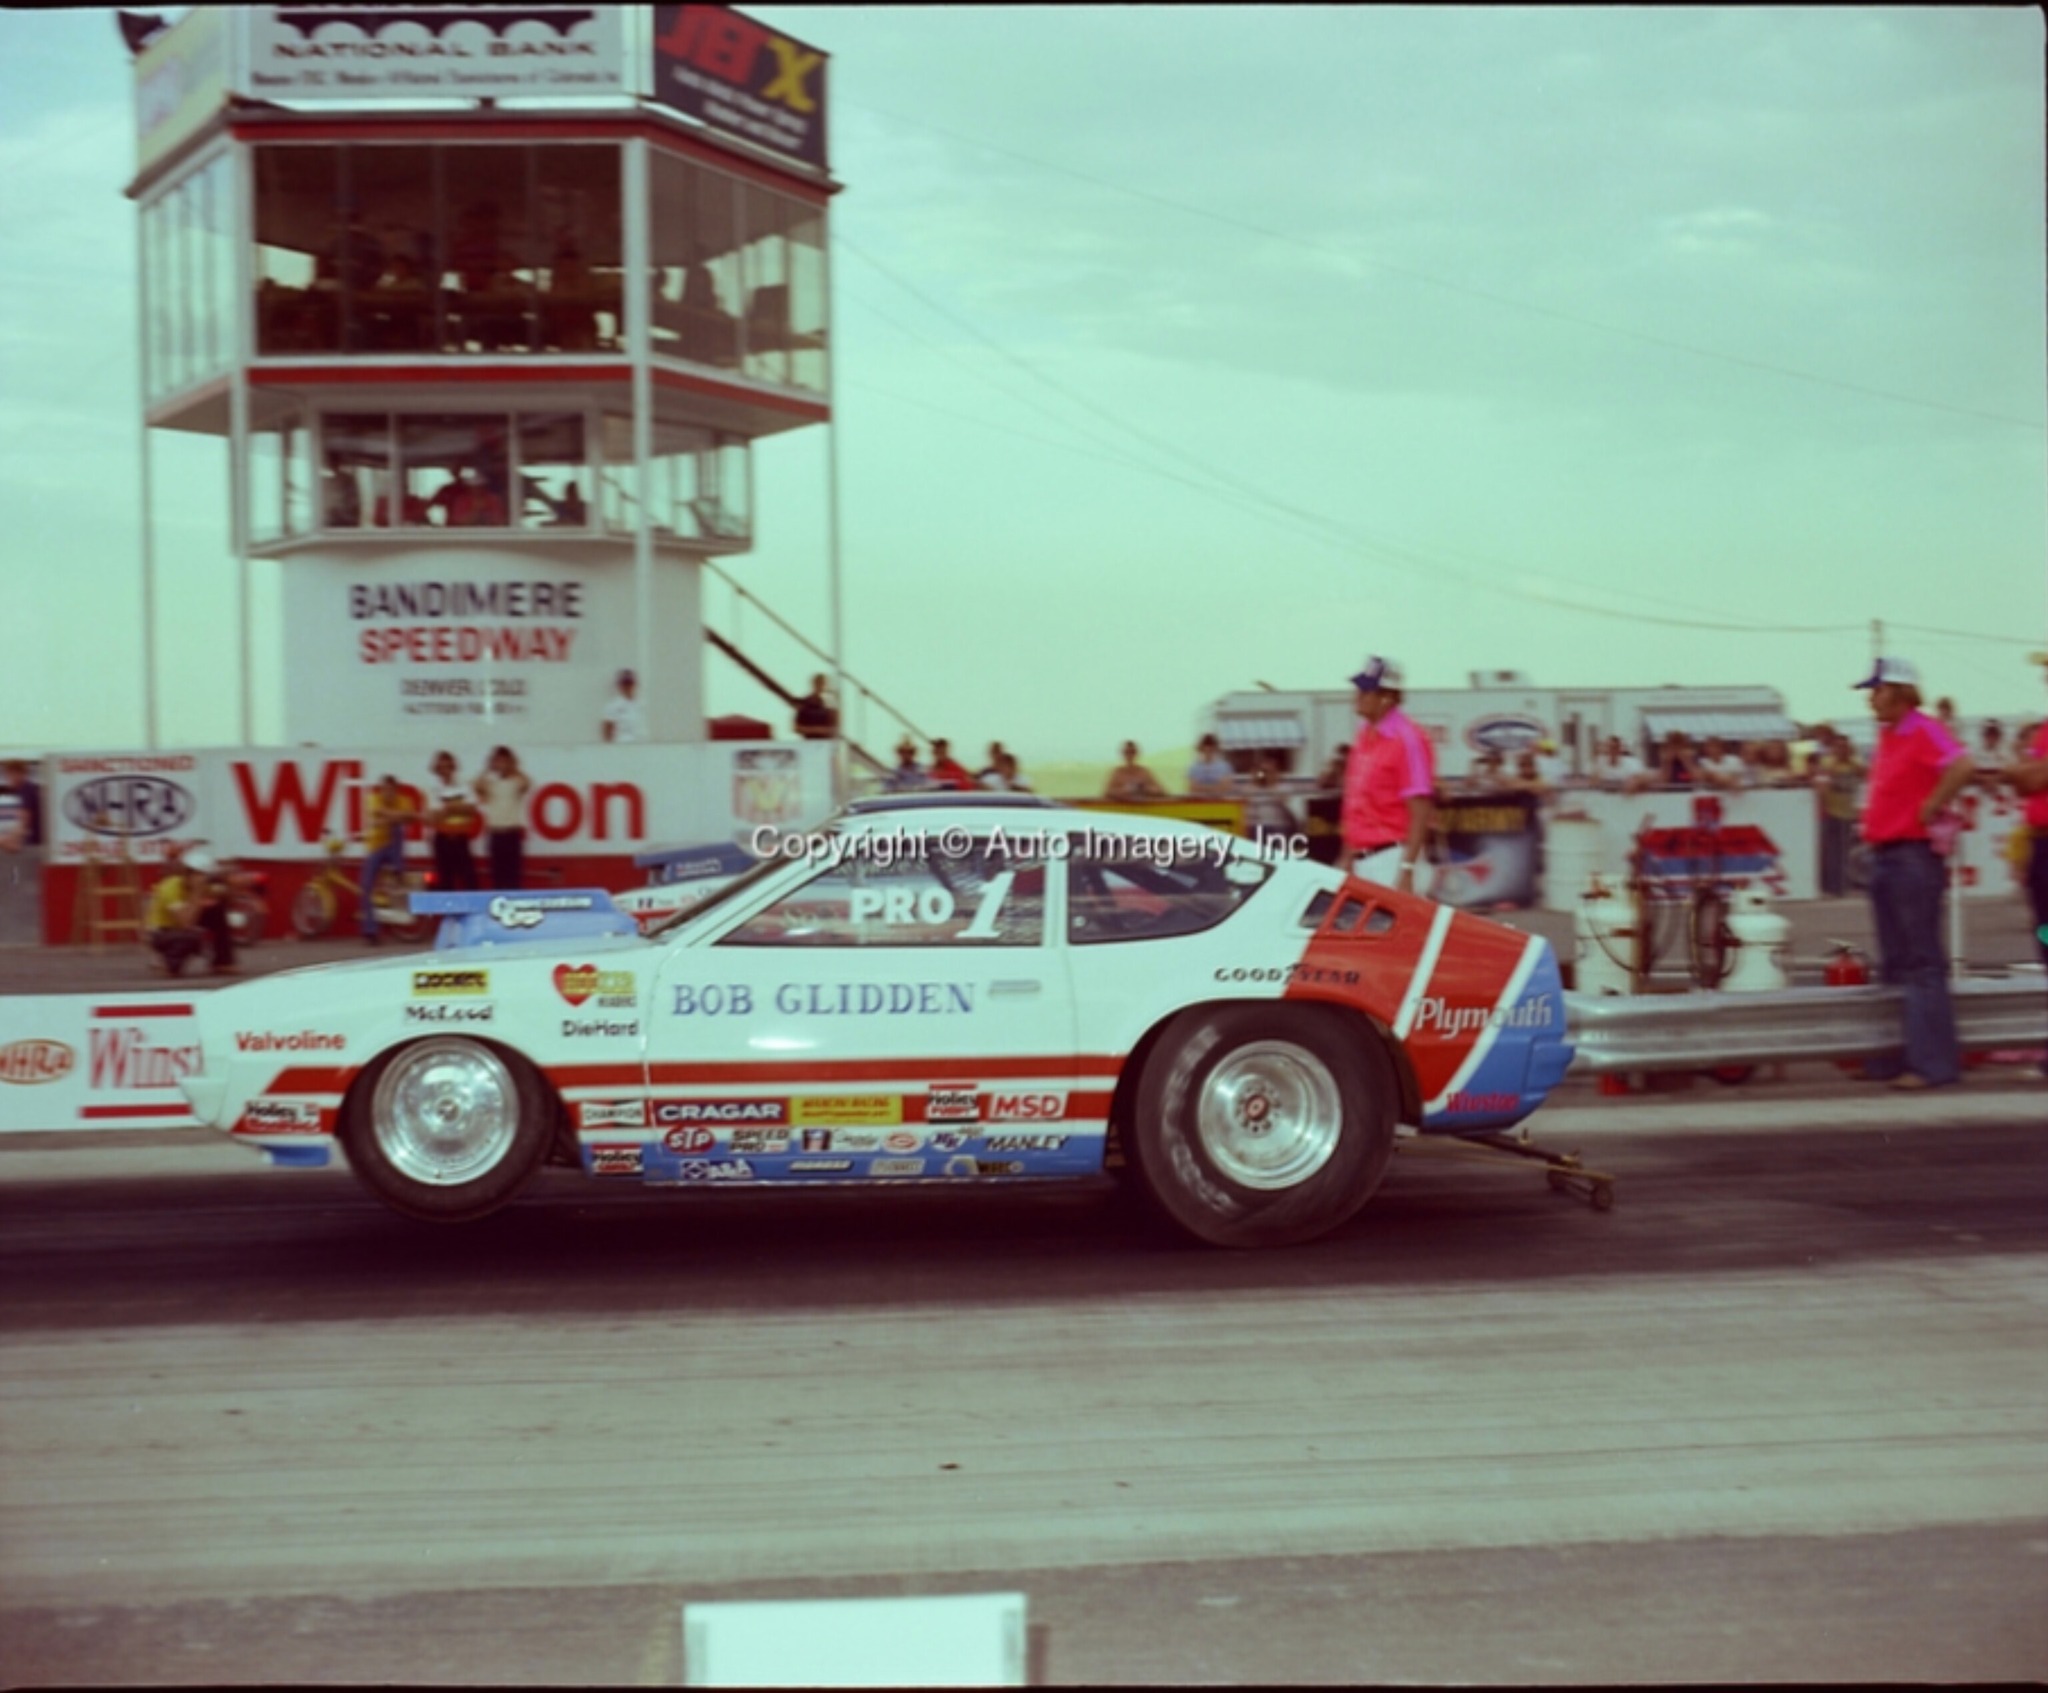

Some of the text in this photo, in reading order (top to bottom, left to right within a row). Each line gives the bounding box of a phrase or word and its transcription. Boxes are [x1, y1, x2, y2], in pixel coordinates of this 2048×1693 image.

[273, 41, 596, 58] NATIONAL BANK
[349, 582, 583, 619] BANDIMERE
[359, 626, 577, 663] SPEEDWAY
[75, 780, 186, 828] NHRA
[230, 760, 645, 843] Wion
[850, 871, 1015, 938] PRO 1
[672, 984, 755, 1016] BOB
[775, 983, 975, 1015] GLIDDEN
[562, 1018, 639, 1037] DieHard
[1415, 994, 1552, 1040] Plymouth
[235, 1030, 345, 1051] Valvoline
[583, 1106, 642, 1121] CHAMPION
[659, 1103, 781, 1121] CRAGAR
[994, 1095, 1061, 1118] MSD
[669, 1129, 711, 1149] STP
[733, 1128, 789, 1141] SPEED
[986, 1134, 1070, 1150] MANLEY
[730, 1142, 766, 1153] PRO
